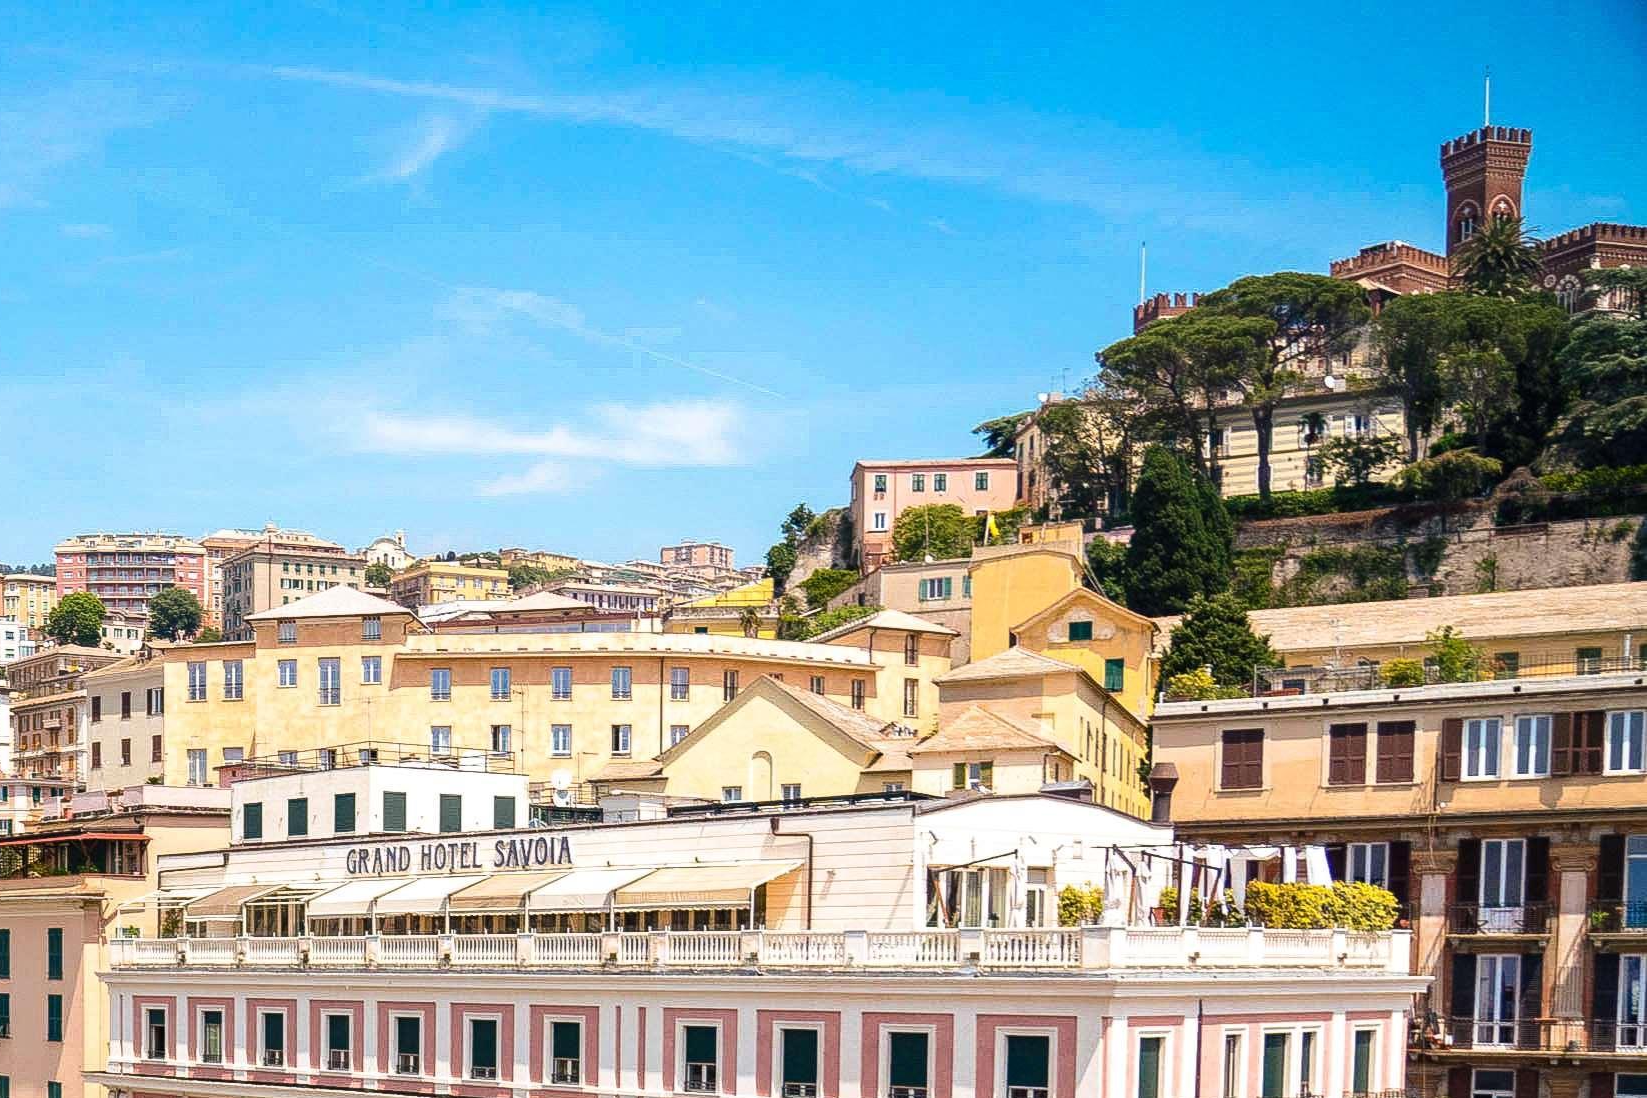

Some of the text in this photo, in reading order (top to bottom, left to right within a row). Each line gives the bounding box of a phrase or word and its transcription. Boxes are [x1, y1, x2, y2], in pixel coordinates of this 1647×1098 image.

[346, 836, 573, 874] GRAND HOTEL SAVOIA
